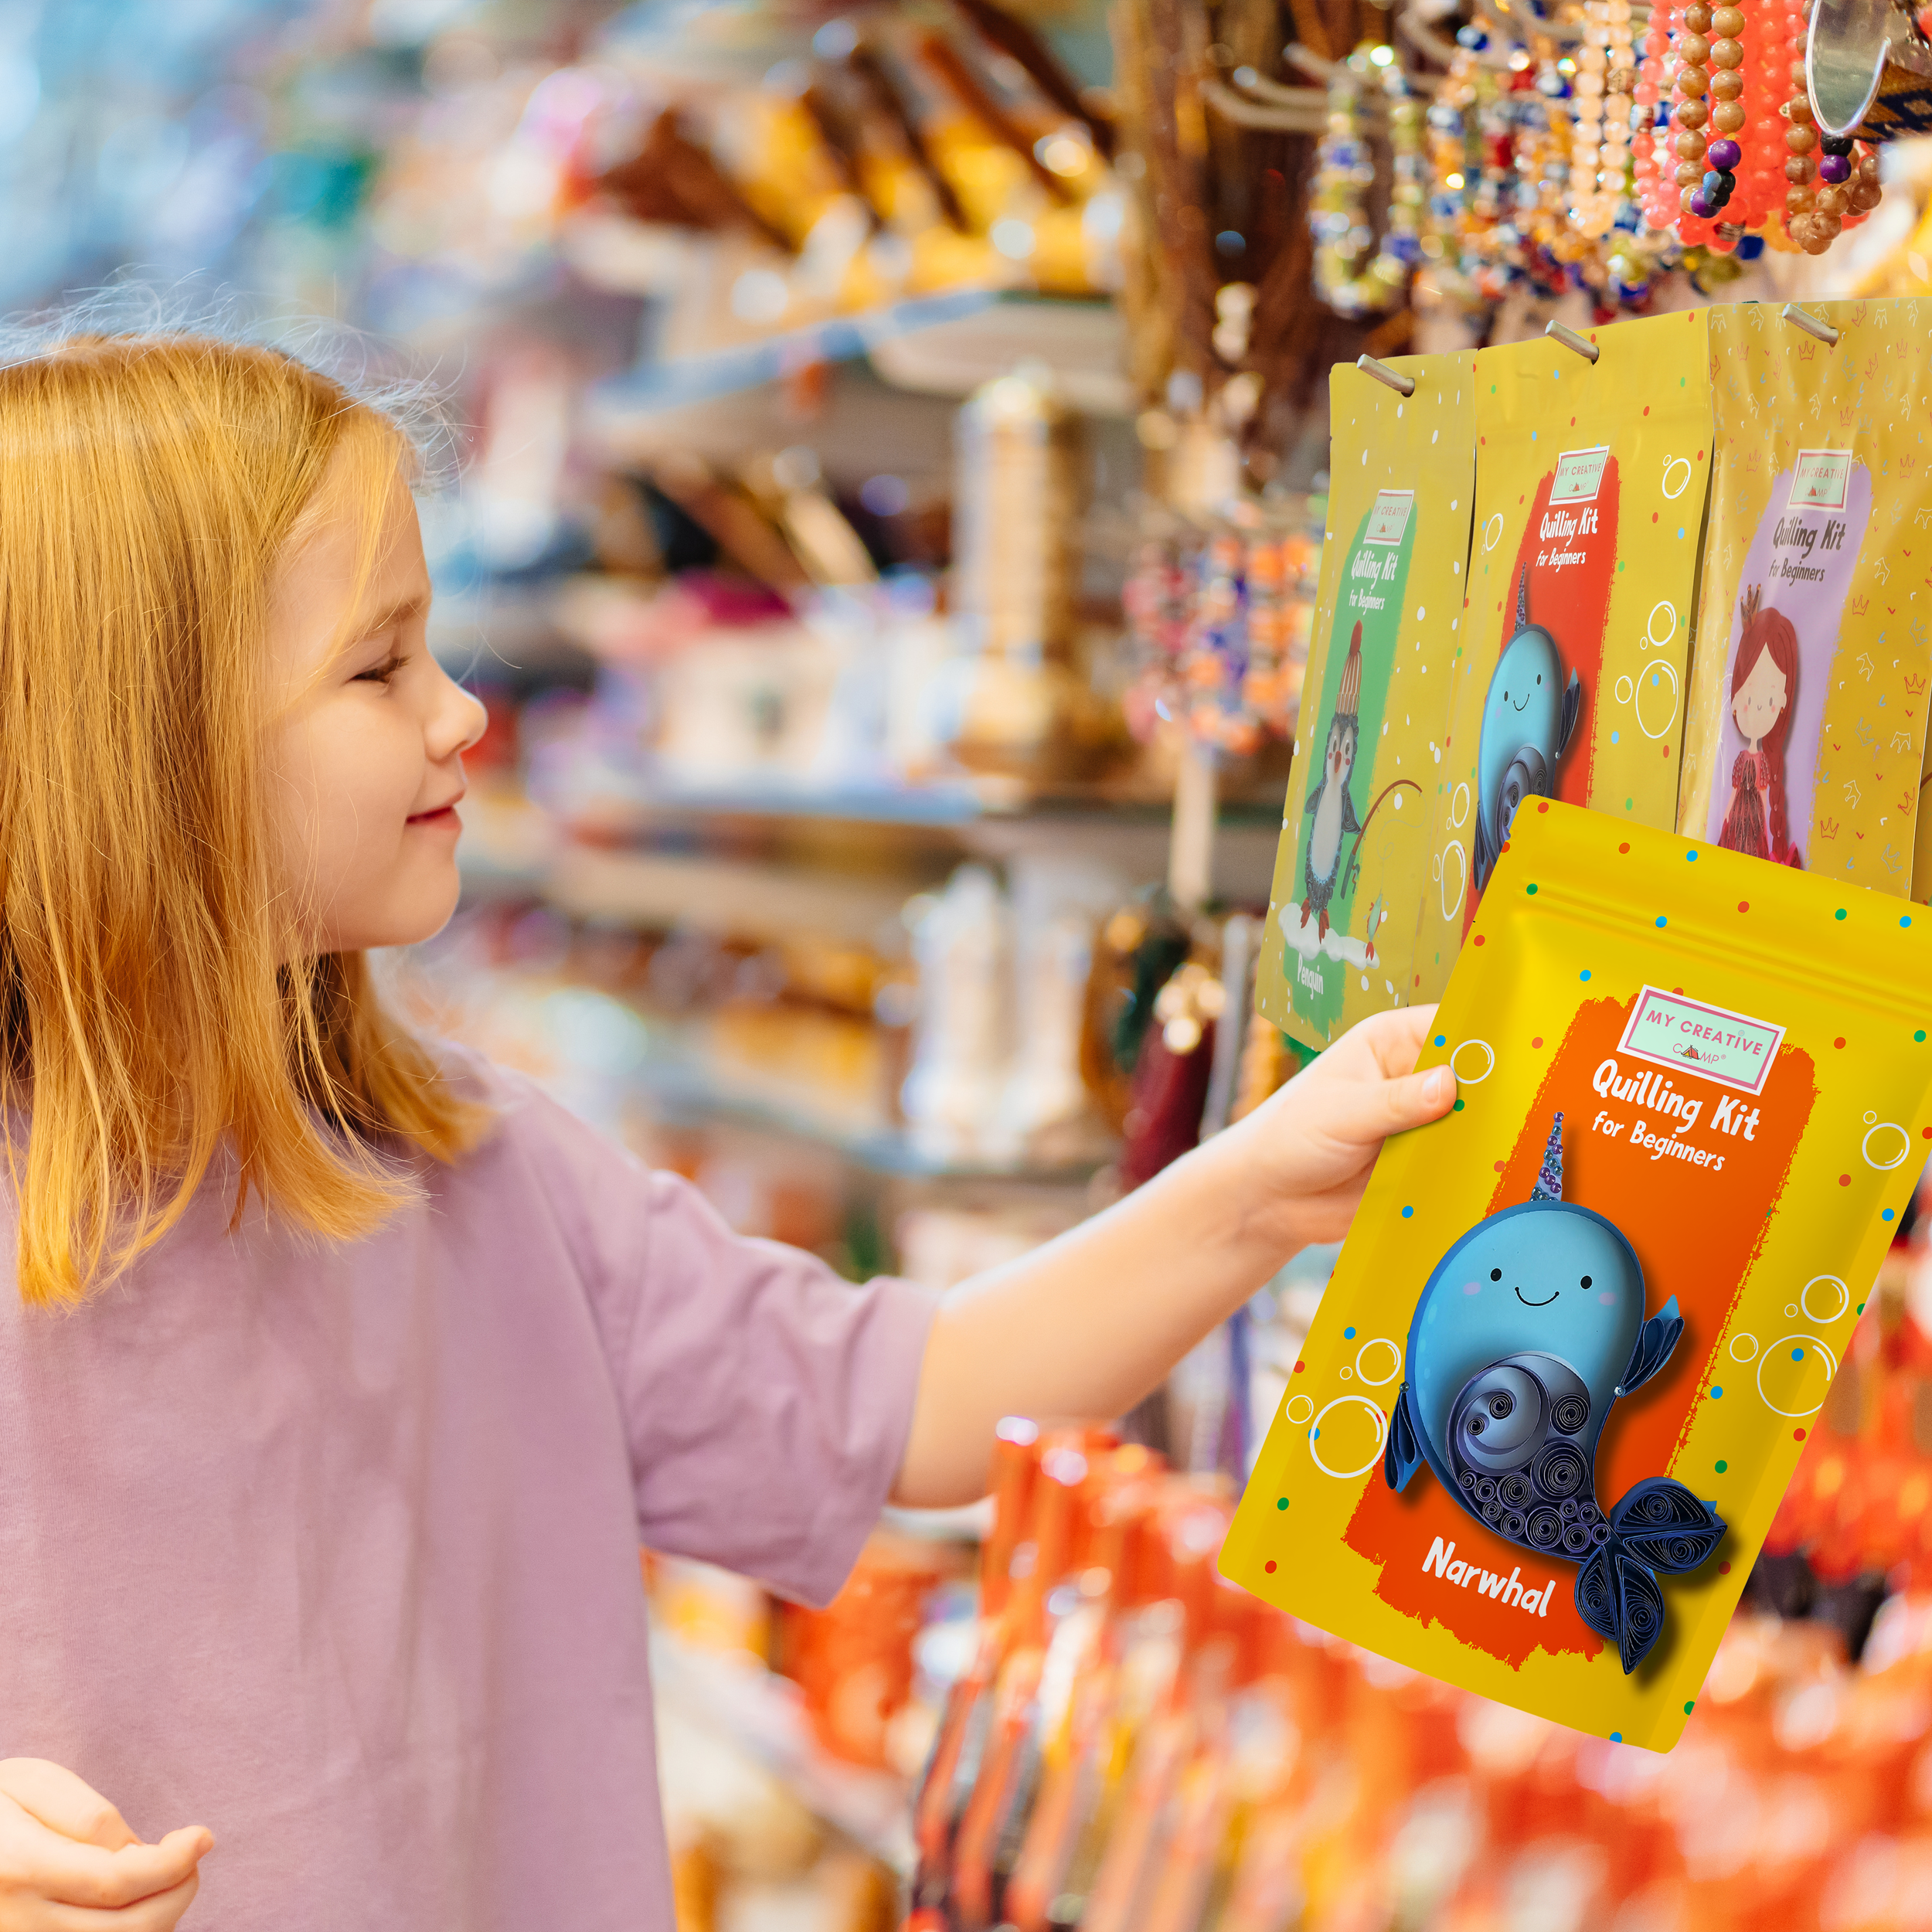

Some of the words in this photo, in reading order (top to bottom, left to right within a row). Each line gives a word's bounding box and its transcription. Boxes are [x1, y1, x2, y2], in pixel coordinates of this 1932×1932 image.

[1559, 467, 1570, 477] MY
[1571, 462, 1602, 476] CREATIVE
[1800, 468, 1811, 478] MY
[1811, 468, 1844, 480] CREATIVE
[1381, 506, 1407, 517] CREATIVE
[1539, 510, 1578, 547] Quilling
[1578, 507, 1598, 535] Kit
[1773, 516, 1818, 560] Quilling
[1820, 519, 1846, 551] Kit
[1351, 549, 1382, 590] Quilling
[1381, 552, 1399, 581] Kit
[1536, 549, 1549, 566] for
[1549, 547, 1587, 573] Beginners
[1768, 559, 1780, 578] for
[1781, 557, 1825, 587] Beginners
[1349, 589, 1358, 607] for
[1358, 588, 1385, 615] Beginners
[1297, 952, 1323, 1000] Penguin
[1646, 1010, 1675, 1028] MY
[1680, 1020, 1764, 1056] CREATIVE
[1593, 1059, 1703, 1134] Quilling
[1709, 1094, 1760, 1141] Kit
[1592, 1111, 1624, 1137] for
[1629, 1120, 1725, 1171] Beginners
[1422, 1536, 1556, 1617] Narwhal
